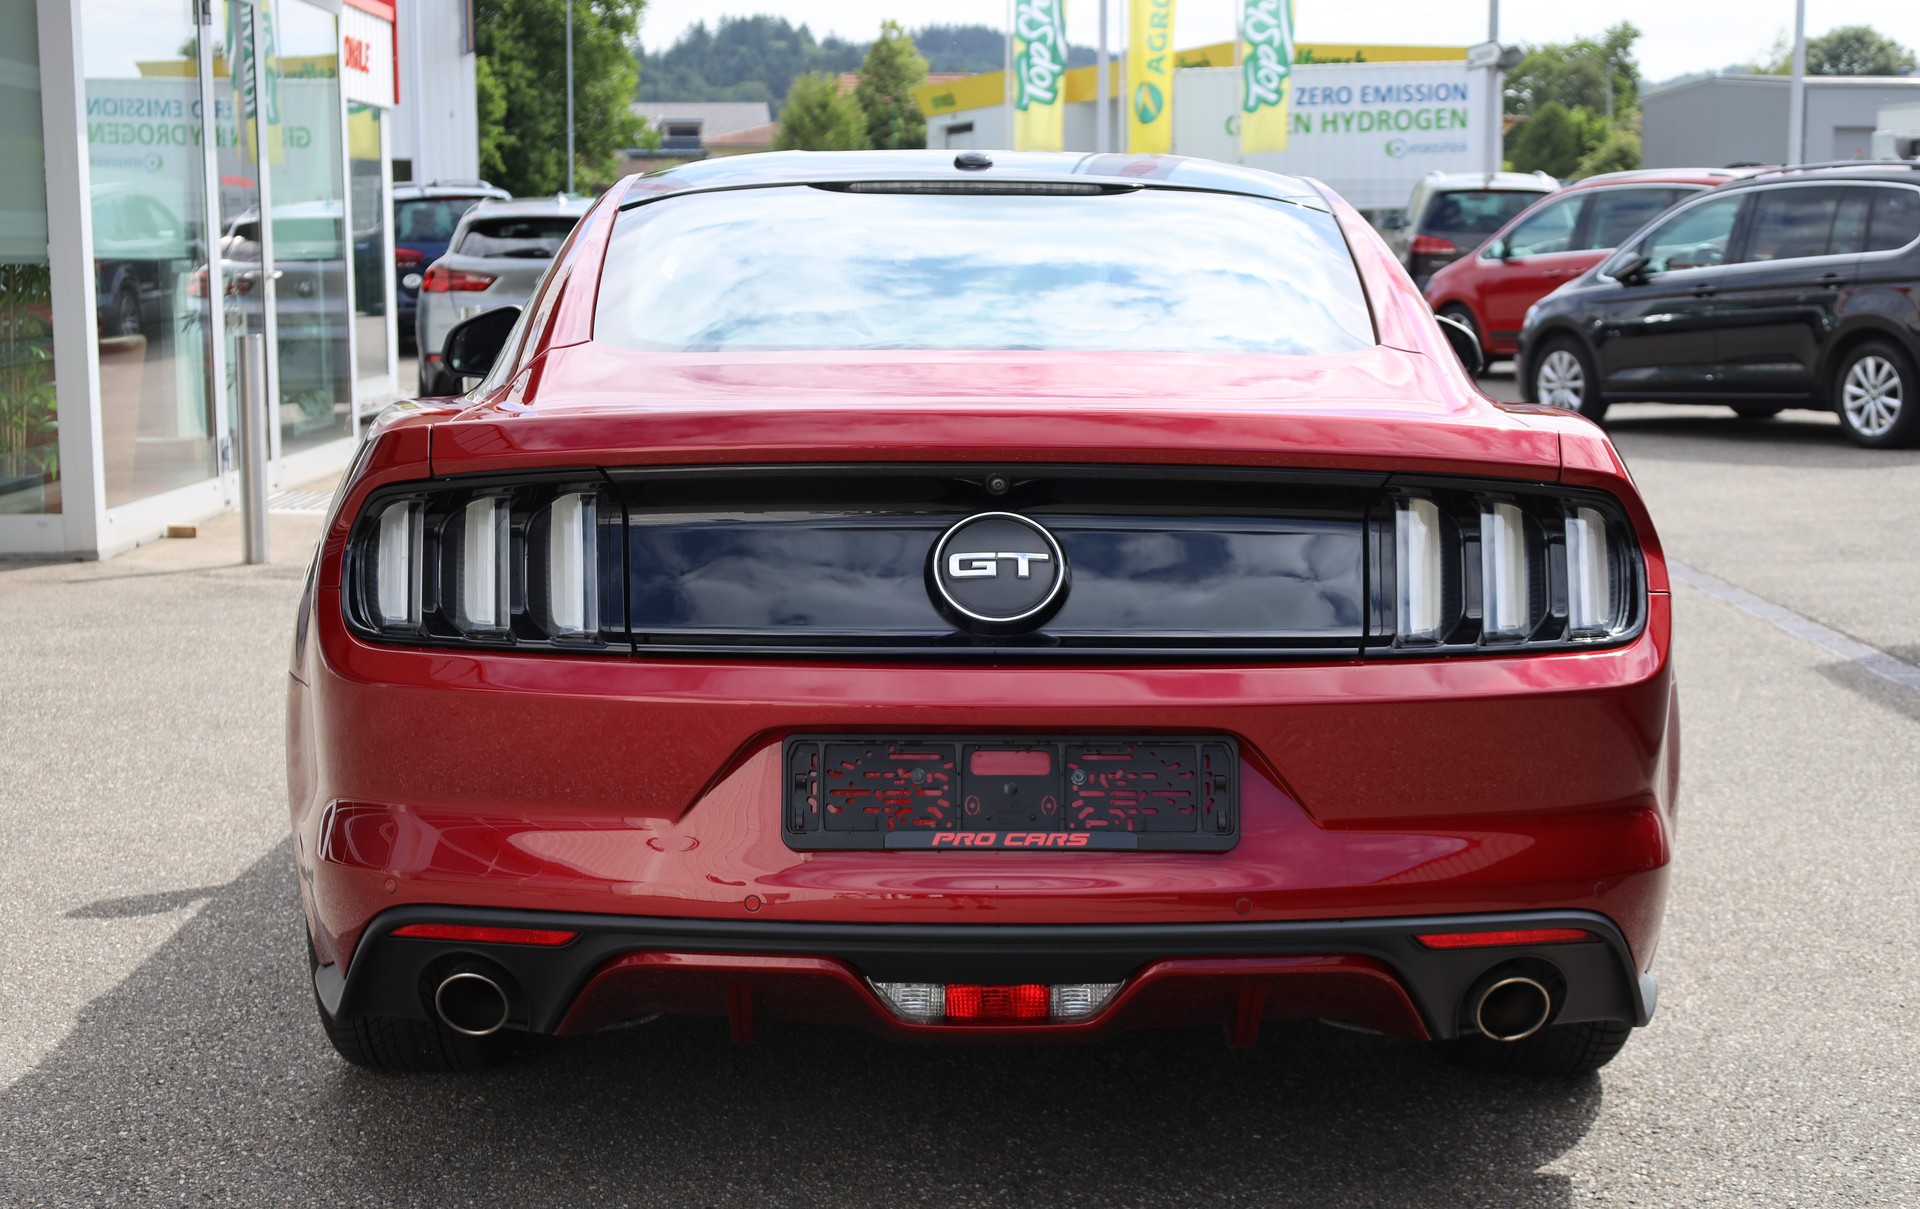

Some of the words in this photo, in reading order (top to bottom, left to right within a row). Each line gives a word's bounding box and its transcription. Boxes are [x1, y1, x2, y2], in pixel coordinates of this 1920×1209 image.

[1296, 86, 1353, 106] ZERO
[1361, 83, 1467, 103] EMISSION
[1321, 108, 1468, 134] HYDROGEN
[948, 551, 1050, 579] GT
[931, 831, 997, 847] PRO
[1003, 831, 1091, 847] CARS
